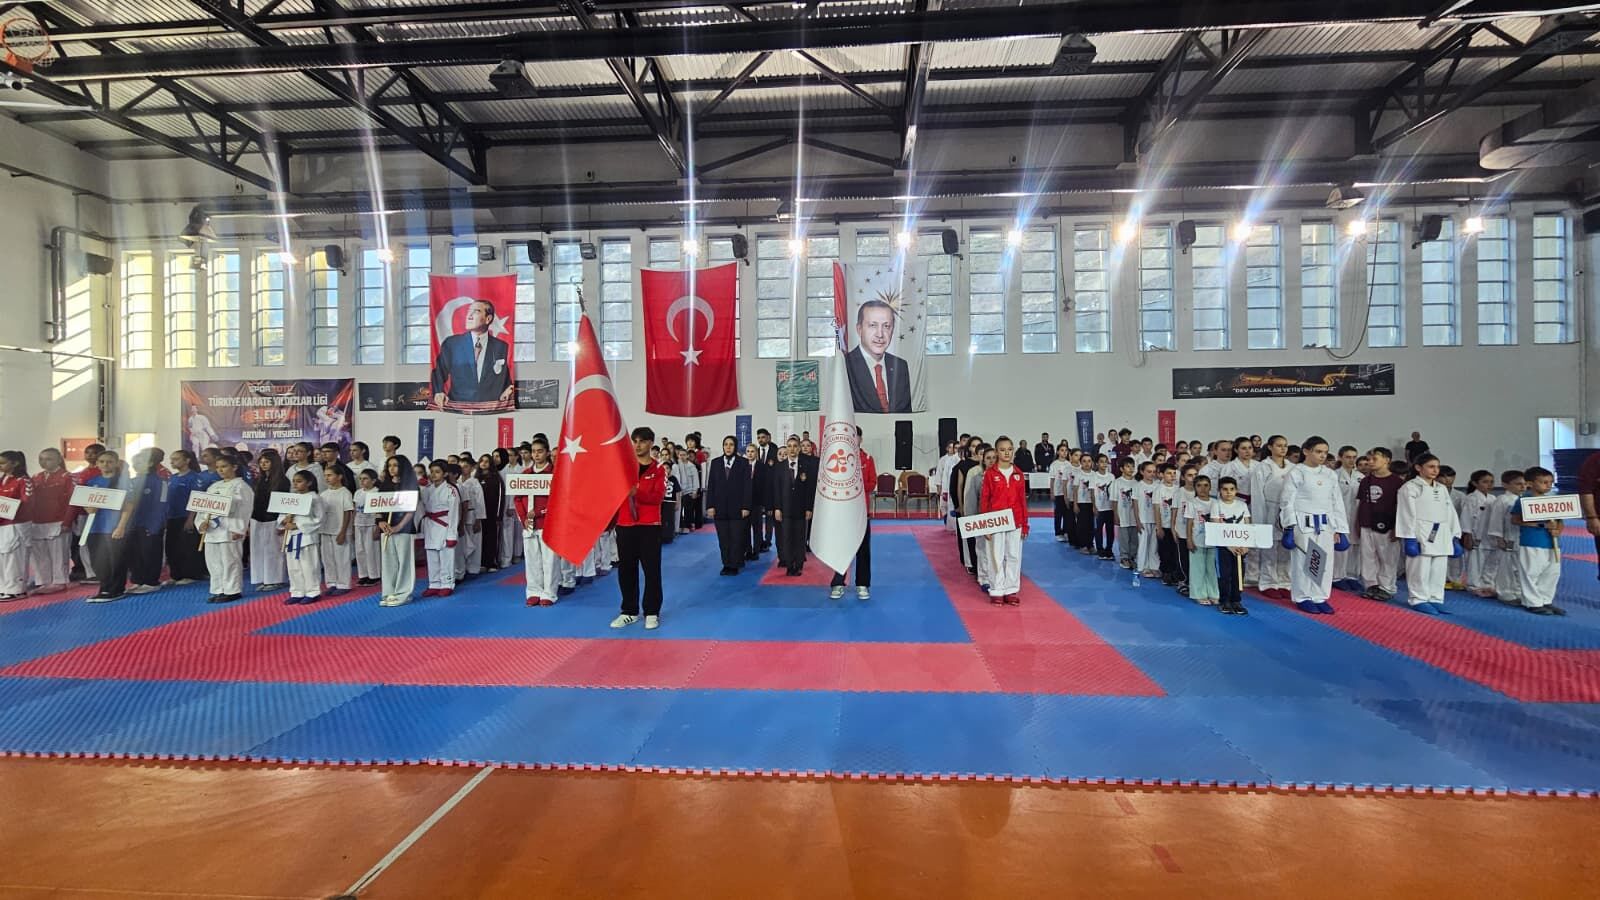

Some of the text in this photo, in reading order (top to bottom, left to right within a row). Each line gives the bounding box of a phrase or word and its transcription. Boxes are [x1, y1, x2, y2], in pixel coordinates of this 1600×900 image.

[208, 395, 240, 406] TÜRKİYE
[240, 397, 272, 406] KARATE
[272, 396, 312, 406] YILDIZLAR
[264, 409, 287, 419] ETAP
[88, 492, 109, 504] RİZE
[280, 497, 300, 507] KARS
[191, 497, 227, 512] ERZİNCAN
[1528, 501, 1574, 515] TRABZON
[965, 515, 1009, 532] SAMSUN
[1223, 529, 1250, 540] MUŞ
